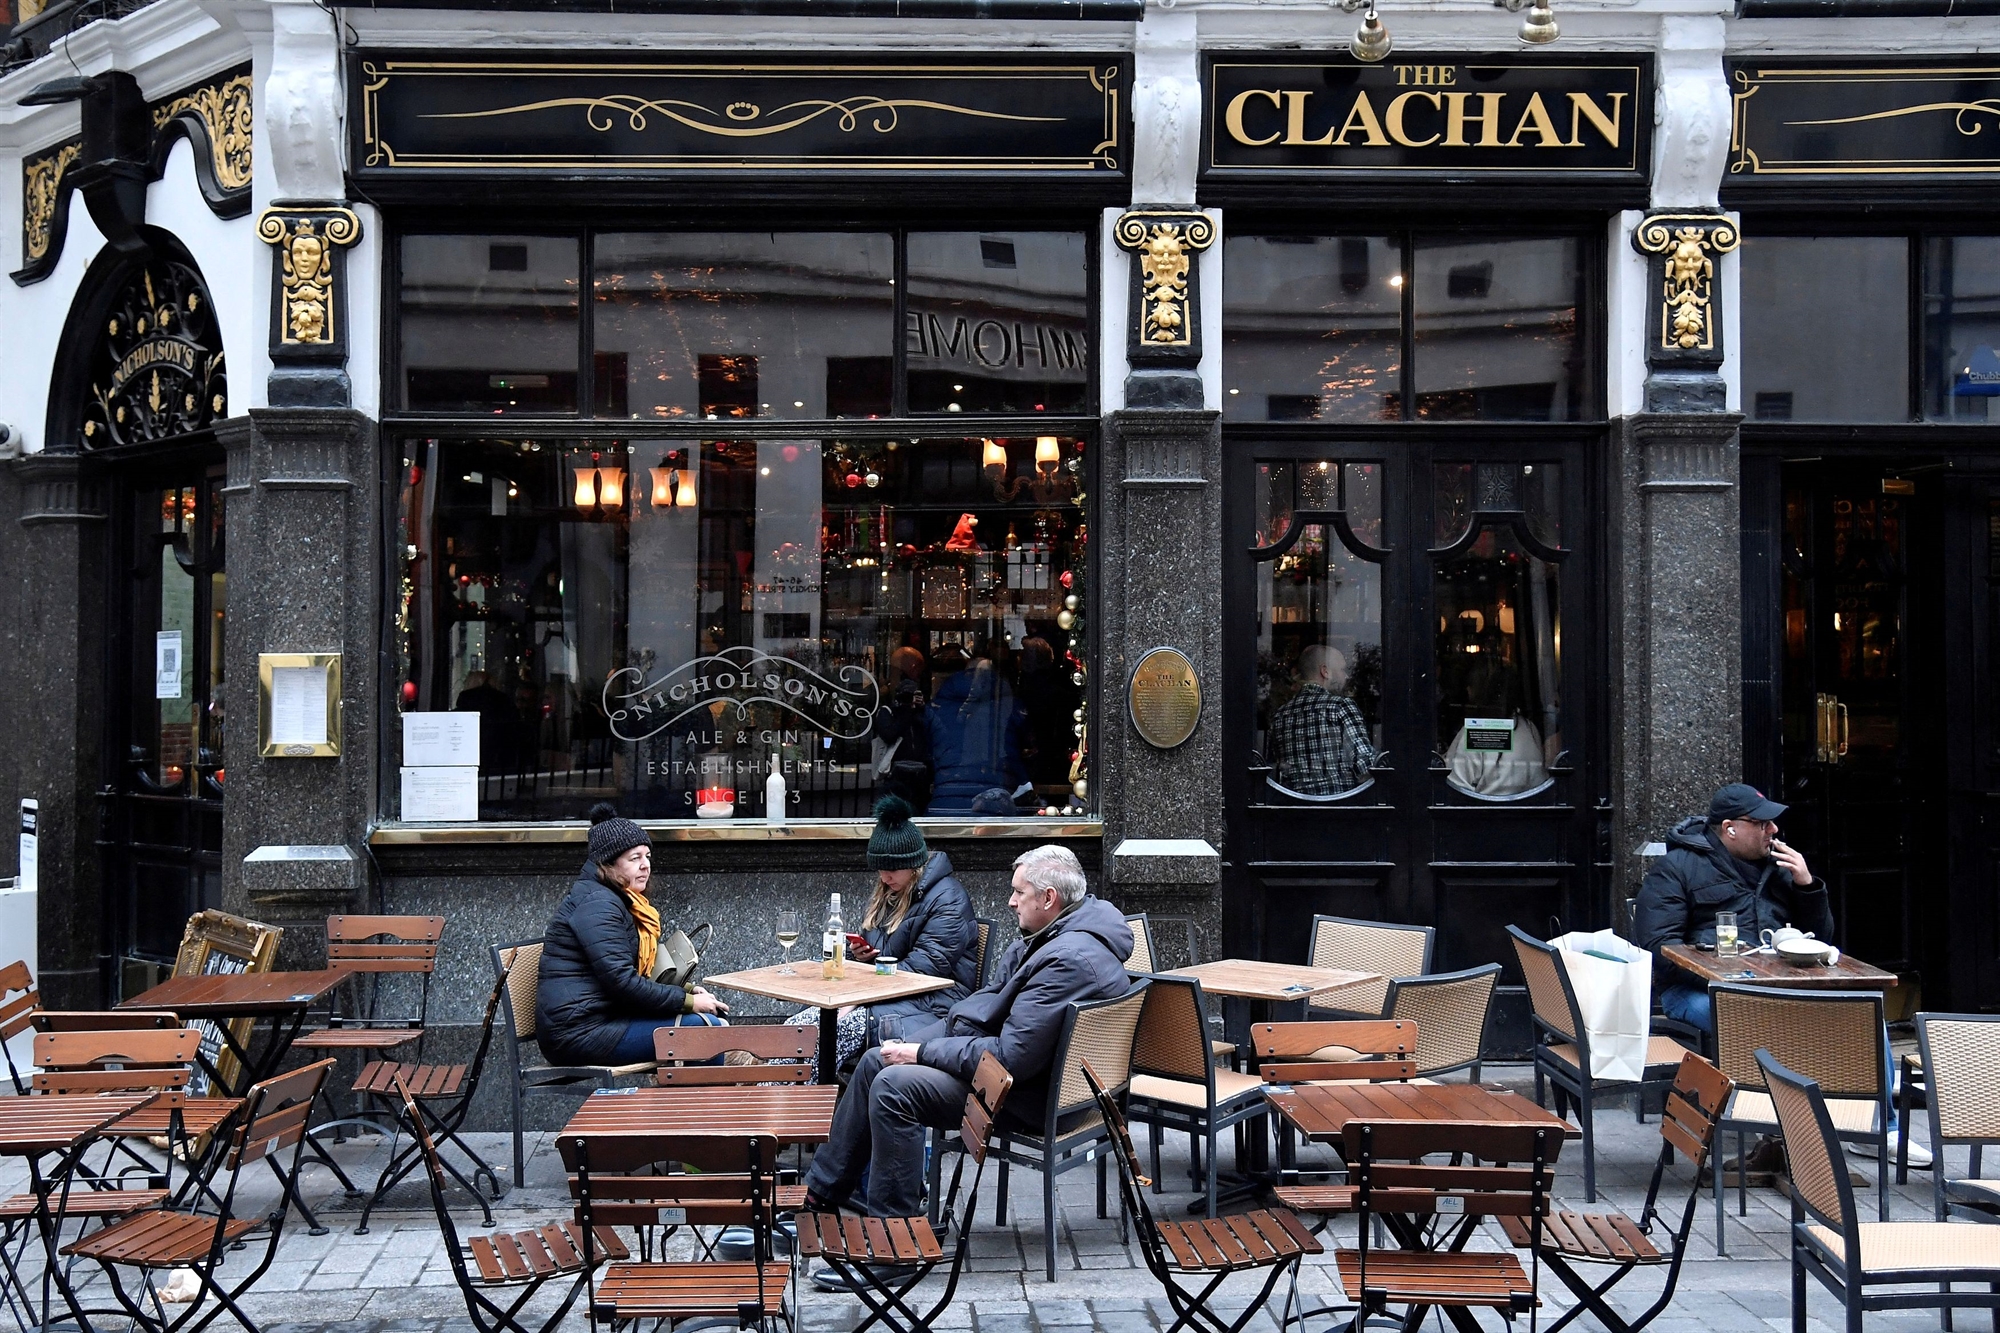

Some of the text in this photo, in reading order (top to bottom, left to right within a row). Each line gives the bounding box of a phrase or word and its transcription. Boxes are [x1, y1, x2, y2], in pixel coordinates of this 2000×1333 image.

[1393, 65, 1456, 86] THE
[1225, 89, 1628, 149] CLACHAN
[112, 340, 195, 391] NICHOLSON'S
[631, 671, 852, 721] NICHOLSON'S
[686, 729, 798, 744] ALE & GIN
[647, 759, 837, 775] ESTABLISHMENTS
[684, 790, 747, 805] SINCE
[1442, 1197, 1459, 1206] AEL
[664, 1209, 681, 1217] AEL
